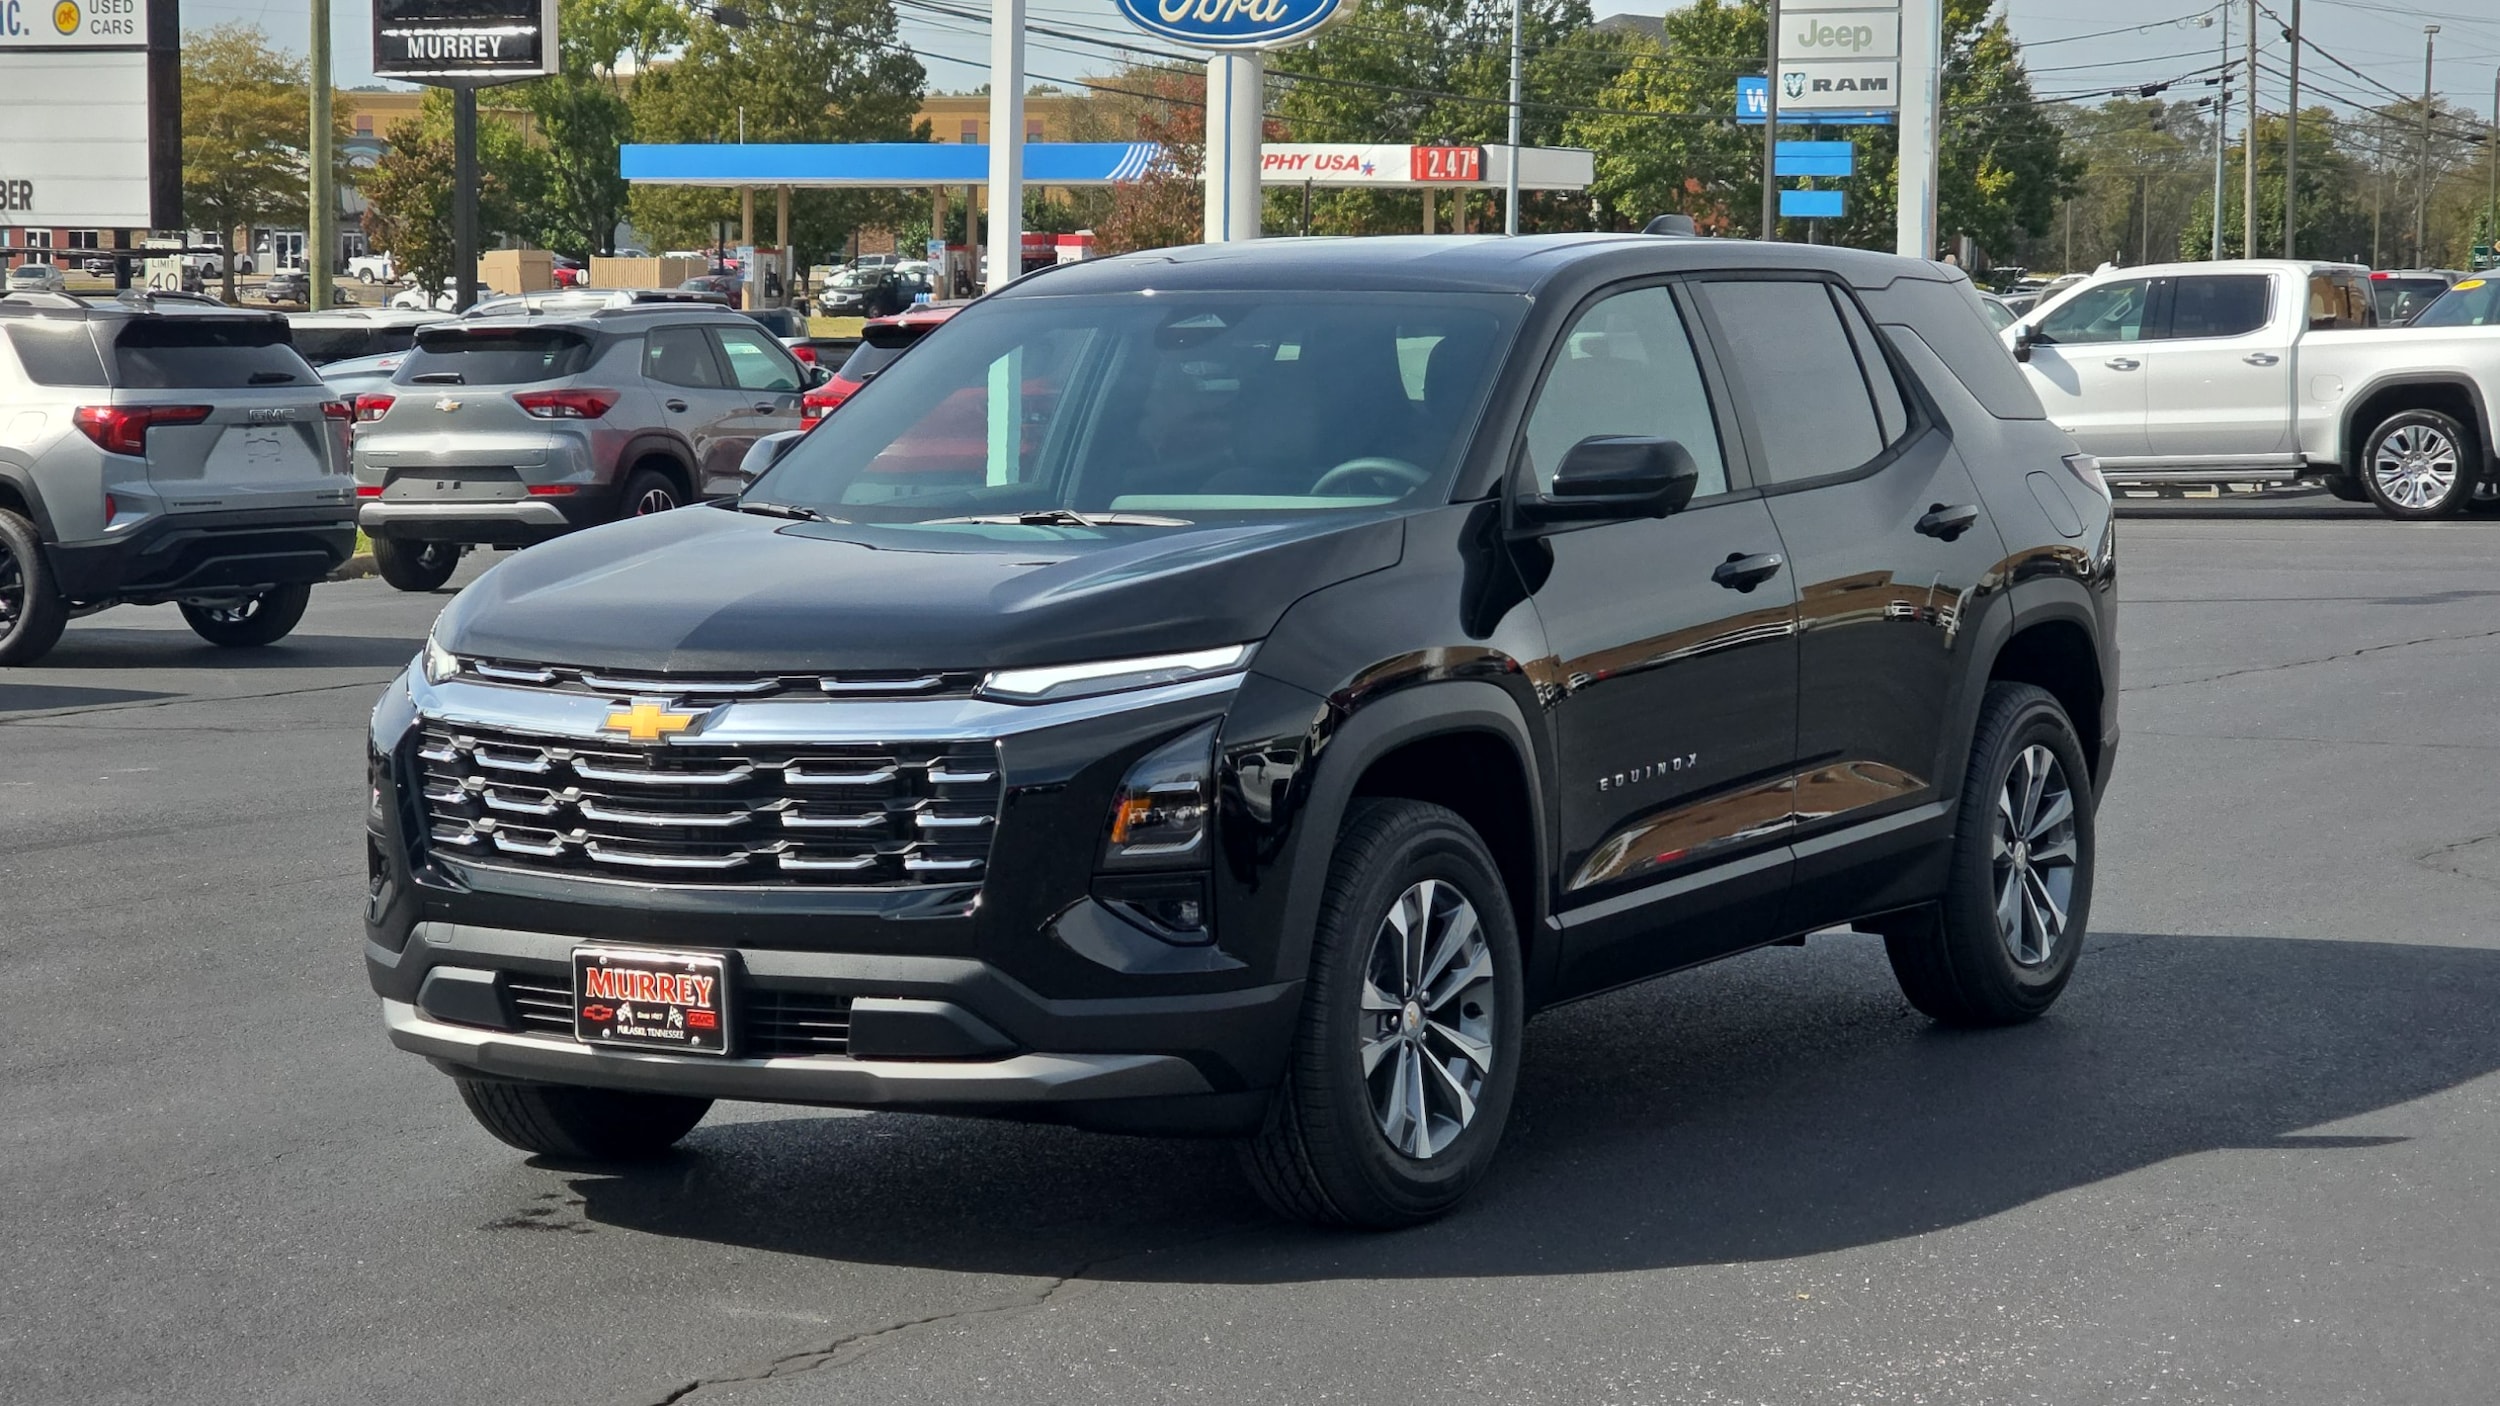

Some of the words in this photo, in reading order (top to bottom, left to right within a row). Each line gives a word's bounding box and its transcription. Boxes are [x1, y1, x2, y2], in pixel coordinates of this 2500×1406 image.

[89, 0, 134, 14] USED
[0, 0, 29, 36] C.
[90, 19, 134, 35] CARS
[1797, 19, 1873, 52] Jeep
[407, 36, 502, 59] MURREY
[1812, 77, 1889, 92] RAM
[1261, 153, 1311, 171] PHY
[1315, 154, 1360, 171] USA
[151, 259, 175, 269] LIMIT
[149, 271, 179, 292] 40
[249, 408, 296, 421] GMC
[1599, 752, 1697, 791] EQUINOX
[585, 966, 713, 1008] MURREY
